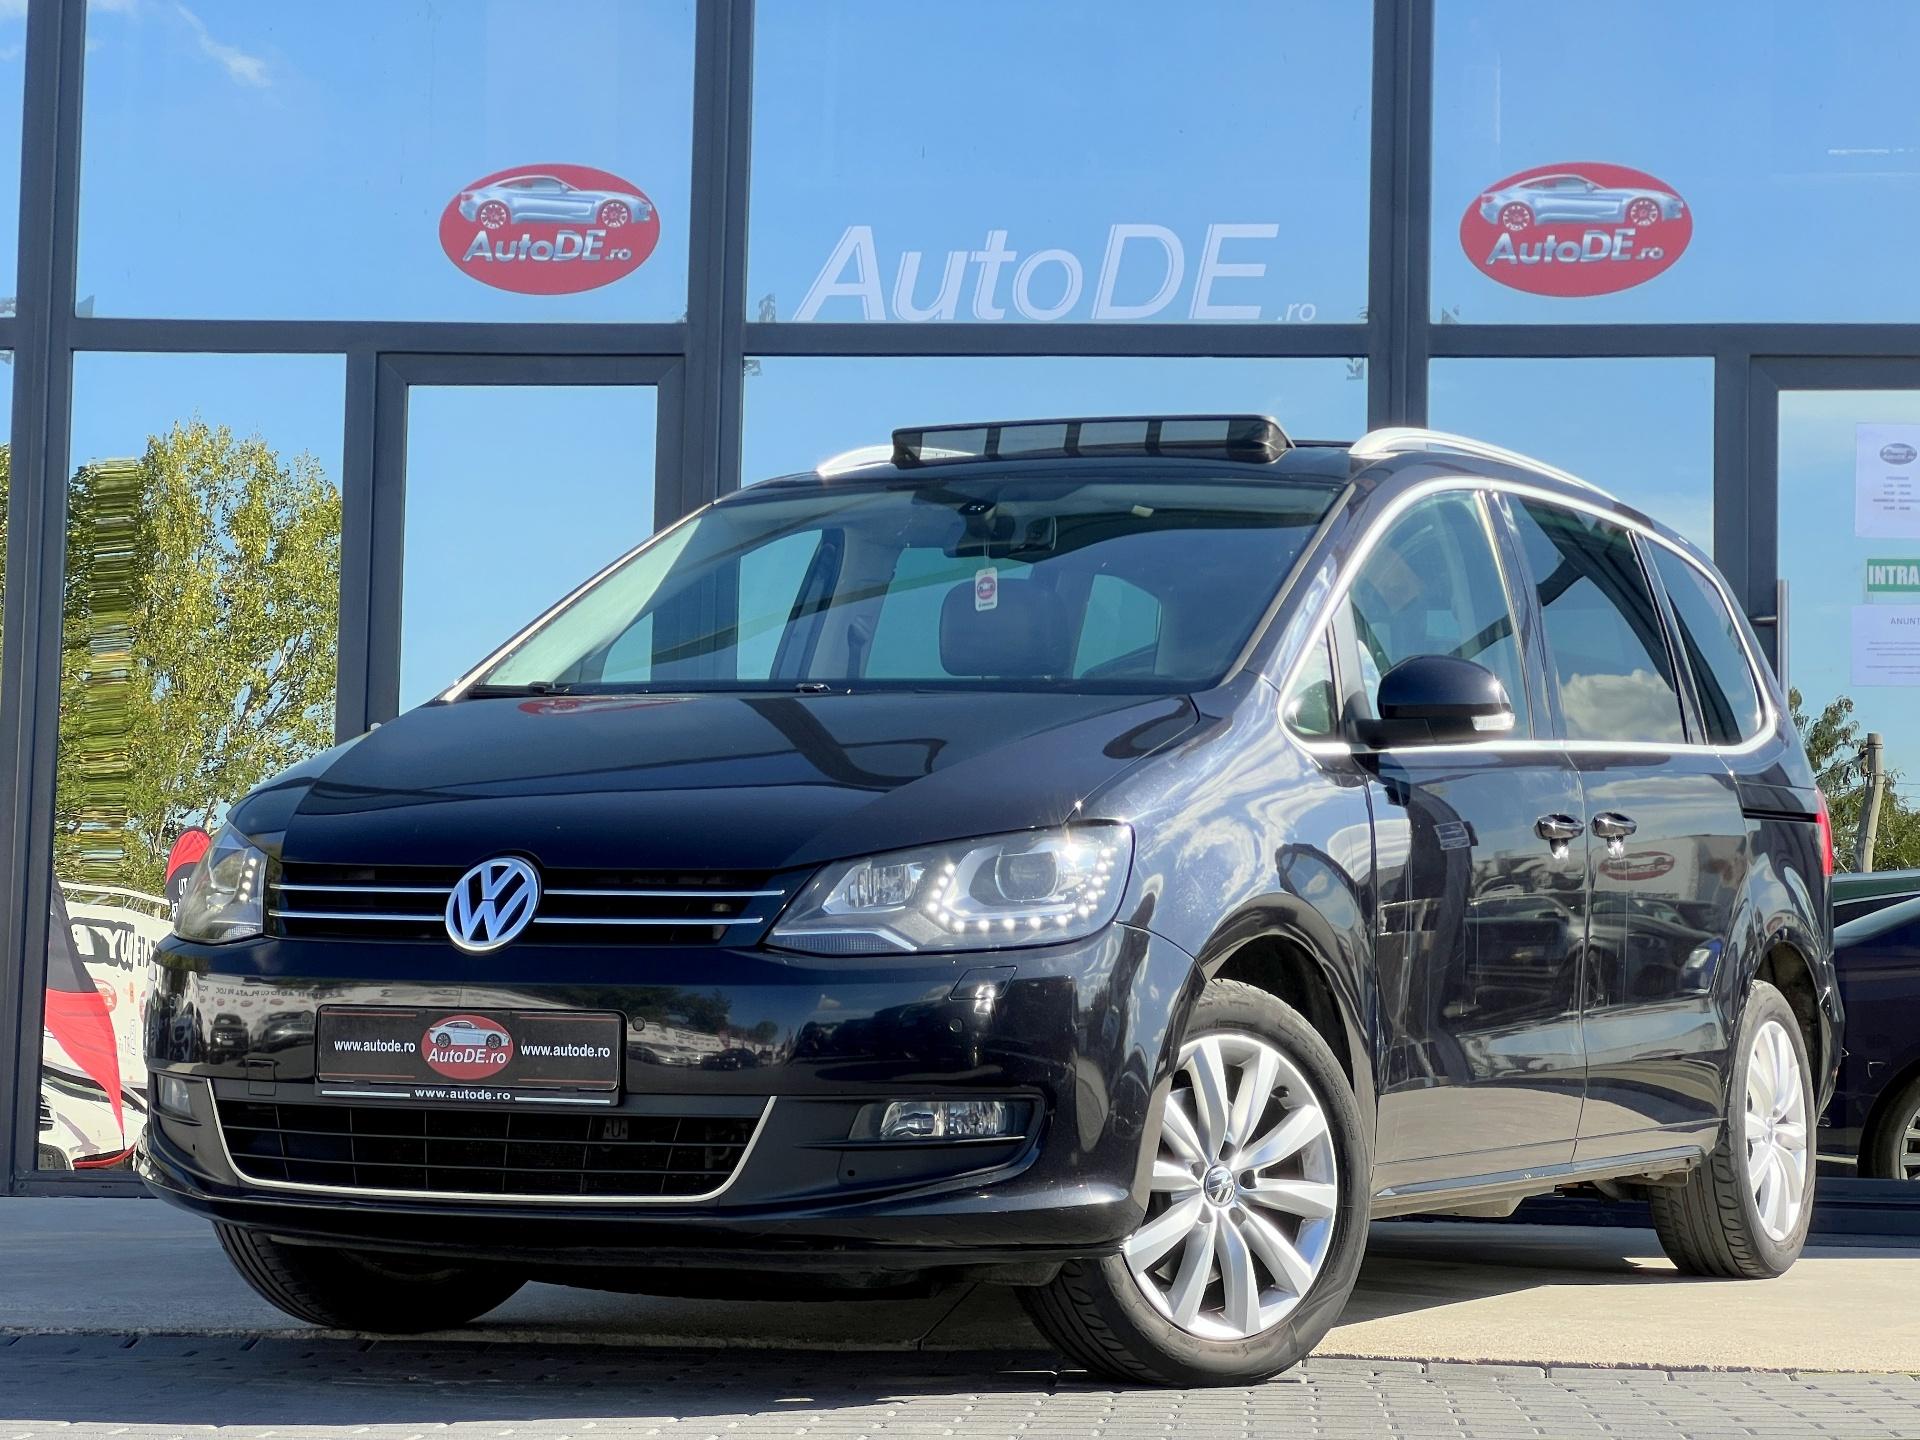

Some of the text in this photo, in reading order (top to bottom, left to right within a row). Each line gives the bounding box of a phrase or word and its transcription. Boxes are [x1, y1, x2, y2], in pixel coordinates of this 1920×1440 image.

[1868, 565, 1920, 585] INTRA
[334, 1039, 611, 1065] www.autode.ro AutoDE.ro www.autode.ro
[414, 1087, 511, 1101] www.autode.ro
